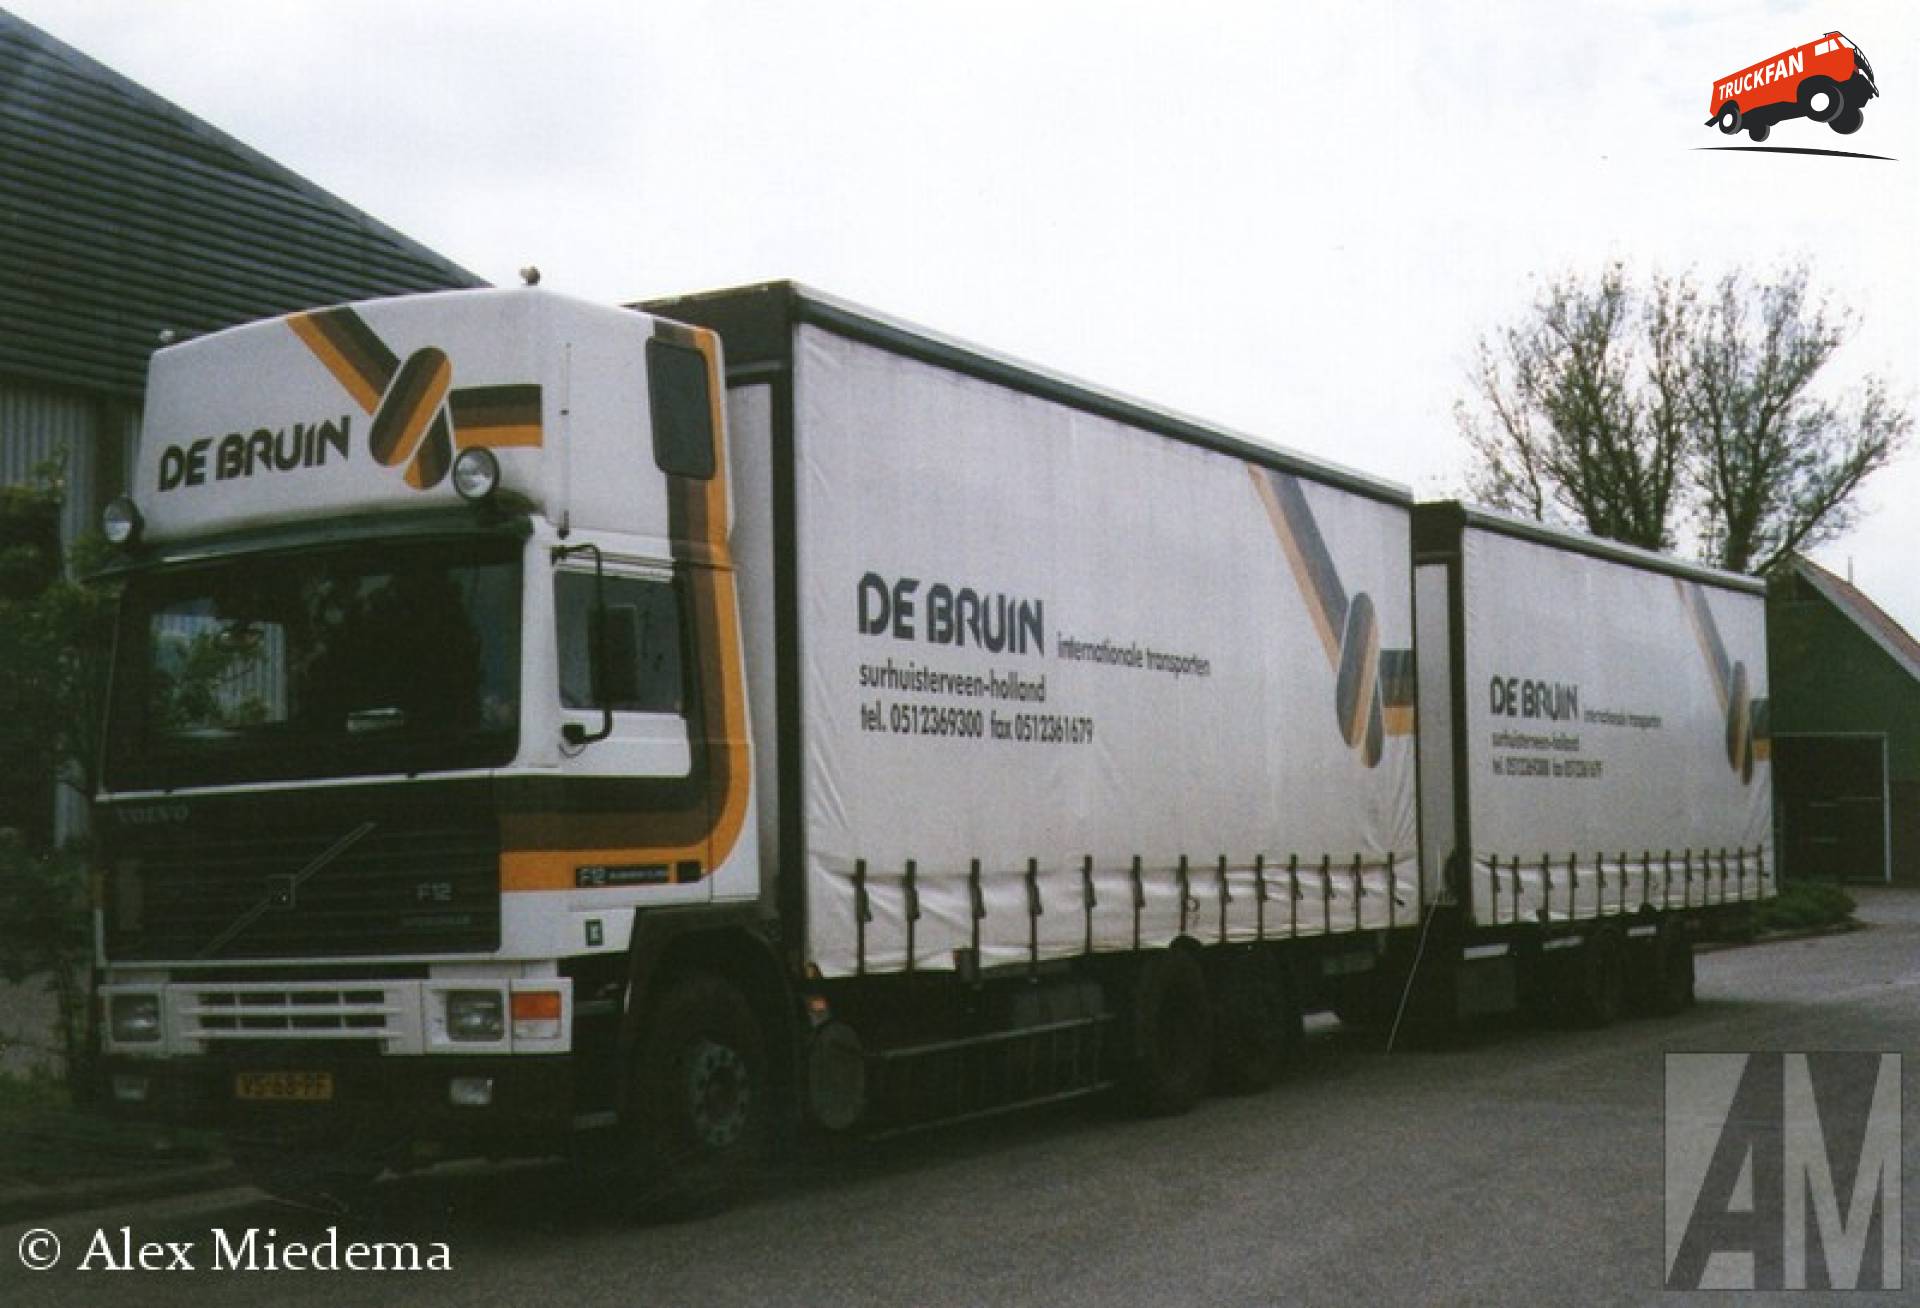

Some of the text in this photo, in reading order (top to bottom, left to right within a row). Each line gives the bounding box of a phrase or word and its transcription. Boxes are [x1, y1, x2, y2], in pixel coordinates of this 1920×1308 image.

[158, 415, 351, 492] DE BRUIN
[857, 570, 1045, 657] DE BRUIN
[858, 656, 1047, 703] surhuisterveen-holland
[1490, 673, 1519, 717] DE
[1521, 679, 1579, 722] BRUIN
[860, 698, 887, 733] tel.
[890, 701, 984, 738] 0512369300
[990, 708, 1012, 741] fax
